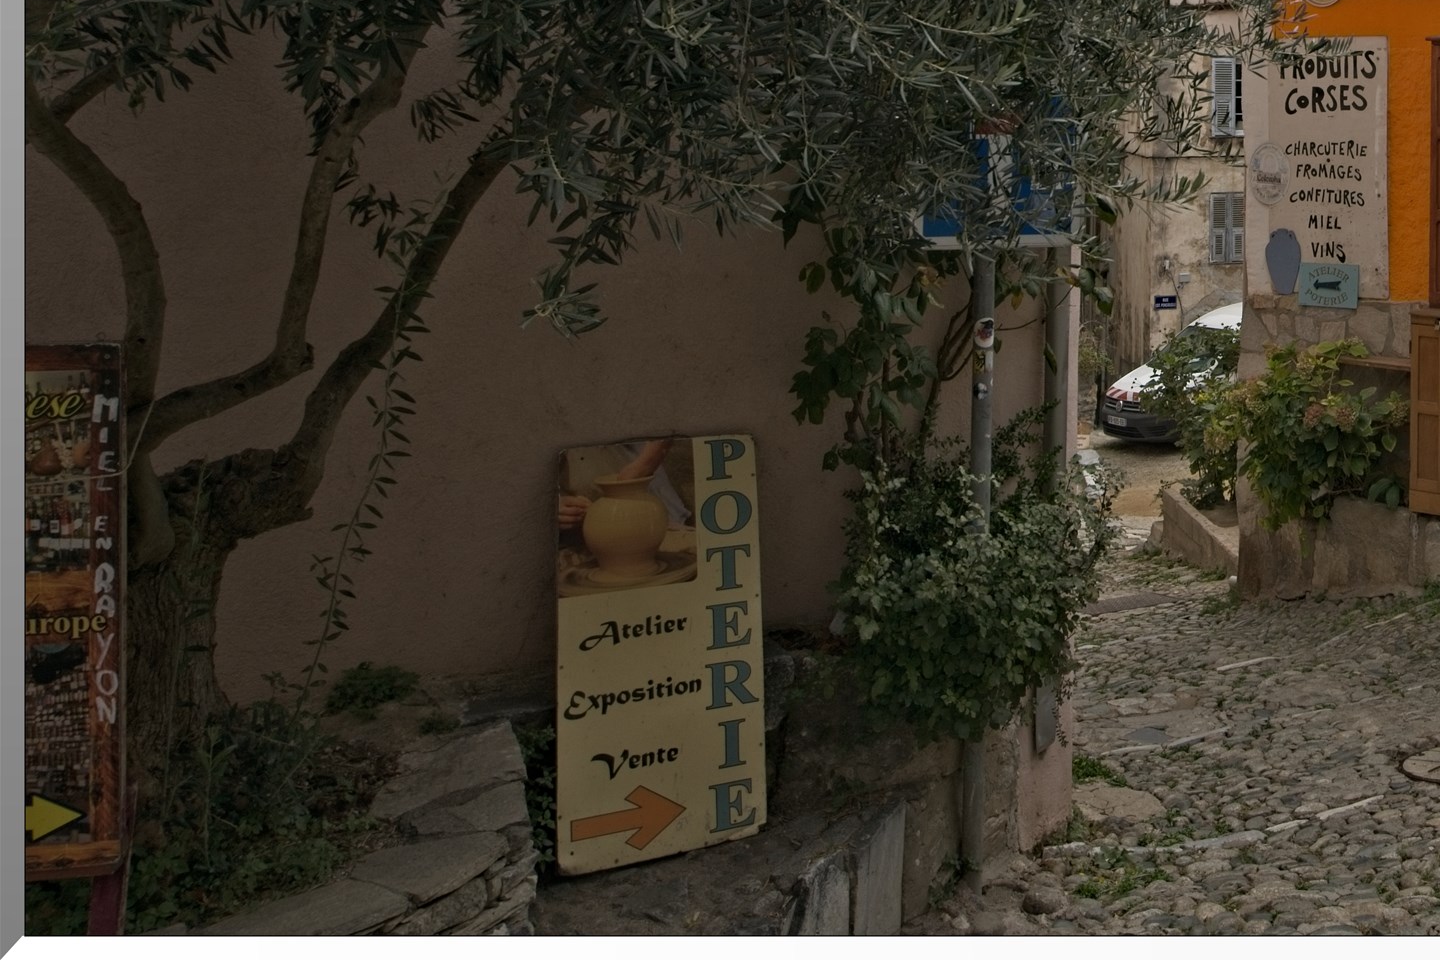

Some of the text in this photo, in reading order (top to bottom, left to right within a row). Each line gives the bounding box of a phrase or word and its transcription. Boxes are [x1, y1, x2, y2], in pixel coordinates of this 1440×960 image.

[1285, 140, 1368, 159] CHARCUTERIE
[1296, 163, 1362, 182] FROMAGES
[1289, 187, 1365, 208] CONFITURES
[1308, 214, 1342, 230] MIEL
[1311, 241, 1347, 263] VINS
[1308, 266, 1350, 283] ATELIER
[1305, 288, 1349, 306] POTERIE
[579, 613, 688, 652] Atelier
[700, 438, 759, 835] POTERIE
[563, 676, 703, 720] Exposition
[590, 744, 680, 780] Vente
